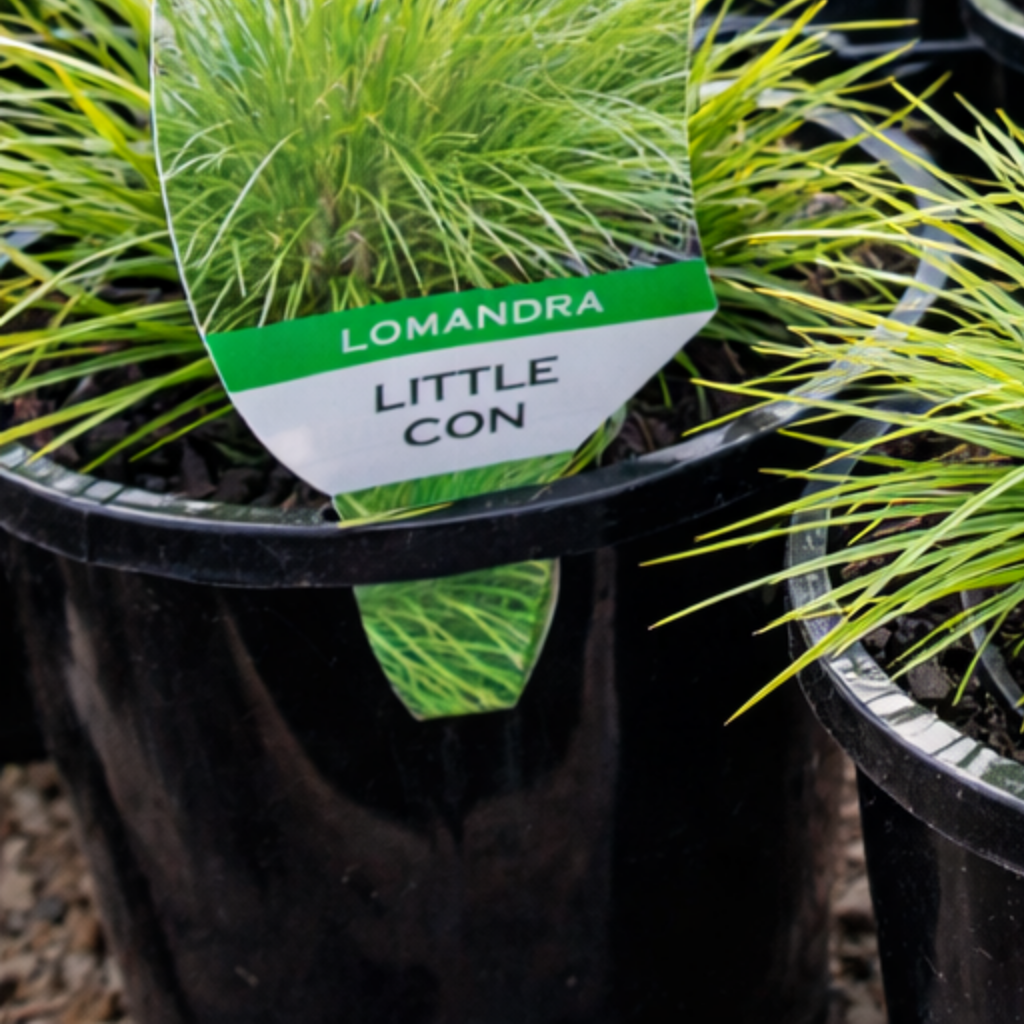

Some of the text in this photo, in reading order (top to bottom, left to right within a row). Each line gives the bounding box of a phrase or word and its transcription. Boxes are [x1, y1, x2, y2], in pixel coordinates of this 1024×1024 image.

[341, 289, 604, 354] LOMANDRA
[375, 355, 559, 414] LITTLE
[403, 402, 525, 447] CON
